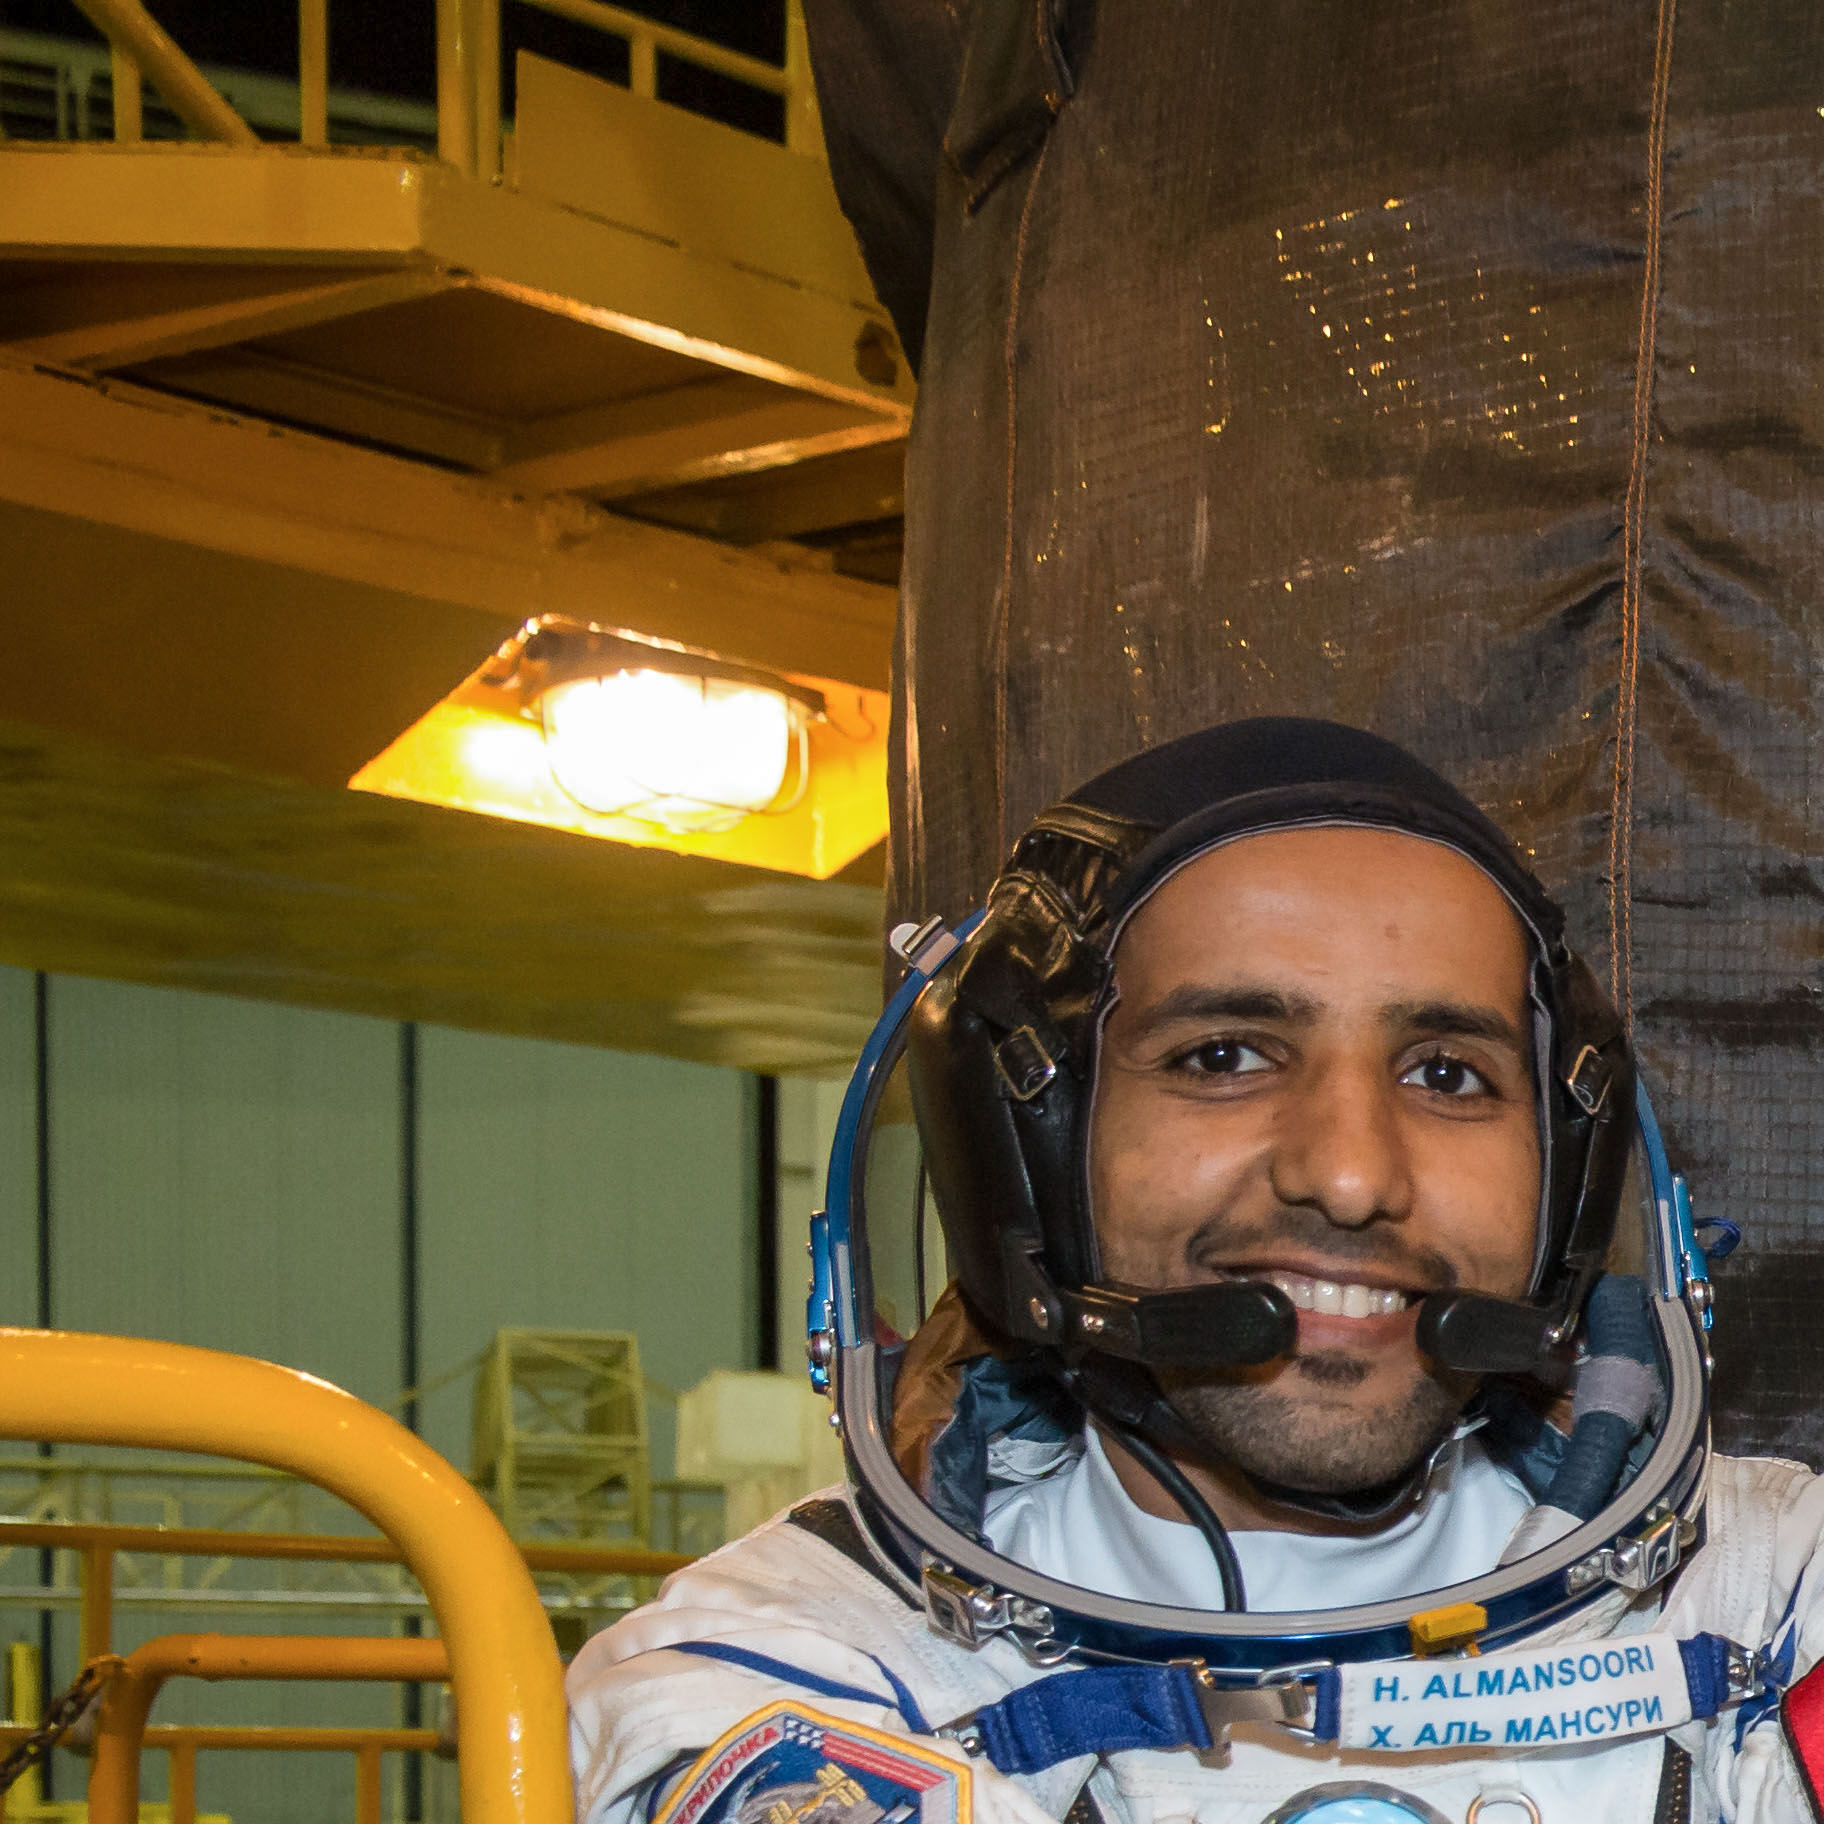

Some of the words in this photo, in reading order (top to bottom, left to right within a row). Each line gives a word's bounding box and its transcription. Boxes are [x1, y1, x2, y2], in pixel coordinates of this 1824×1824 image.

[1373, 1677, 1409, 1702] H.
[1422, 1645, 1654, 1699] ALMANSOORI
[1370, 1725, 1401, 1748] Х.
[1413, 1722, 1492, 1746] АЛЬ
[1504, 1696, 1664, 1743] МАНСУРИ
